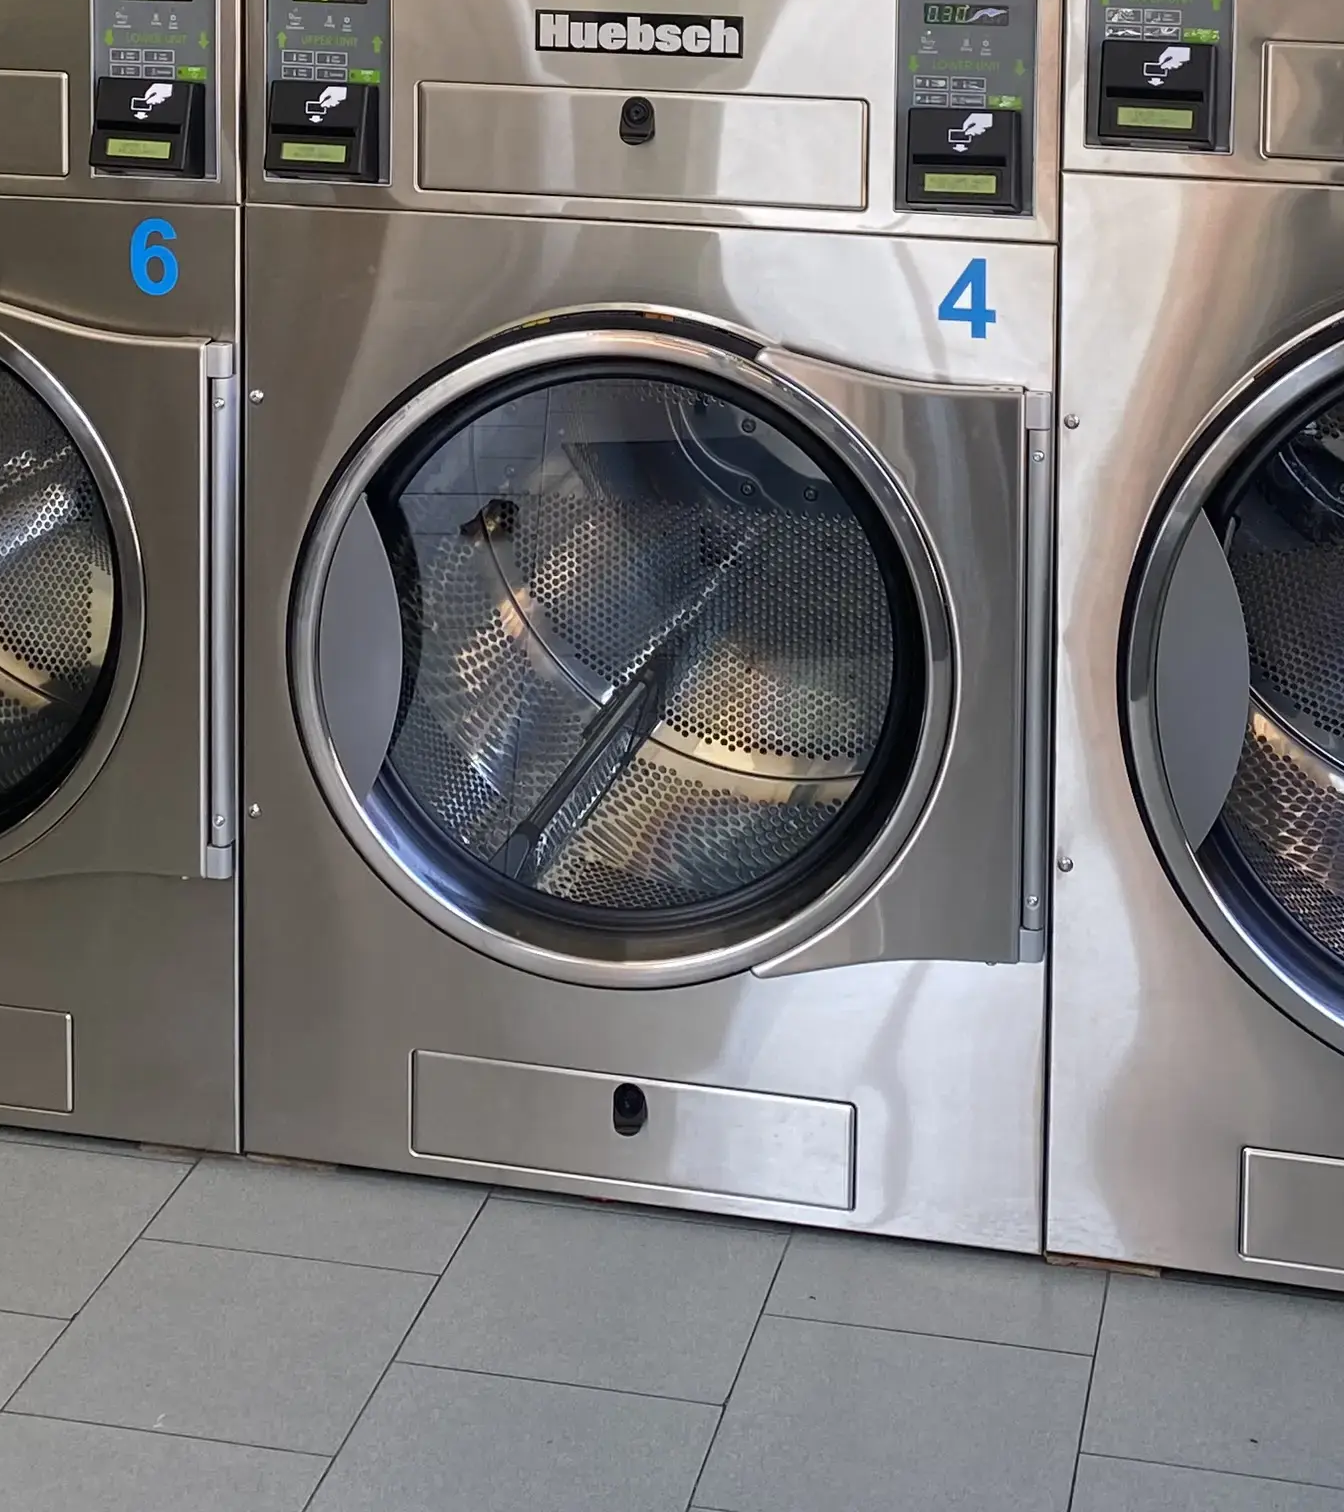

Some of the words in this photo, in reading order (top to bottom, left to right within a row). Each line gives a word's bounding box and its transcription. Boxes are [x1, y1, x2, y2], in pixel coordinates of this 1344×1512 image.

[539, 13, 740, 54] Huebsch
[129, 217, 179, 297] 6
[937, 256, 997, 339] 4
